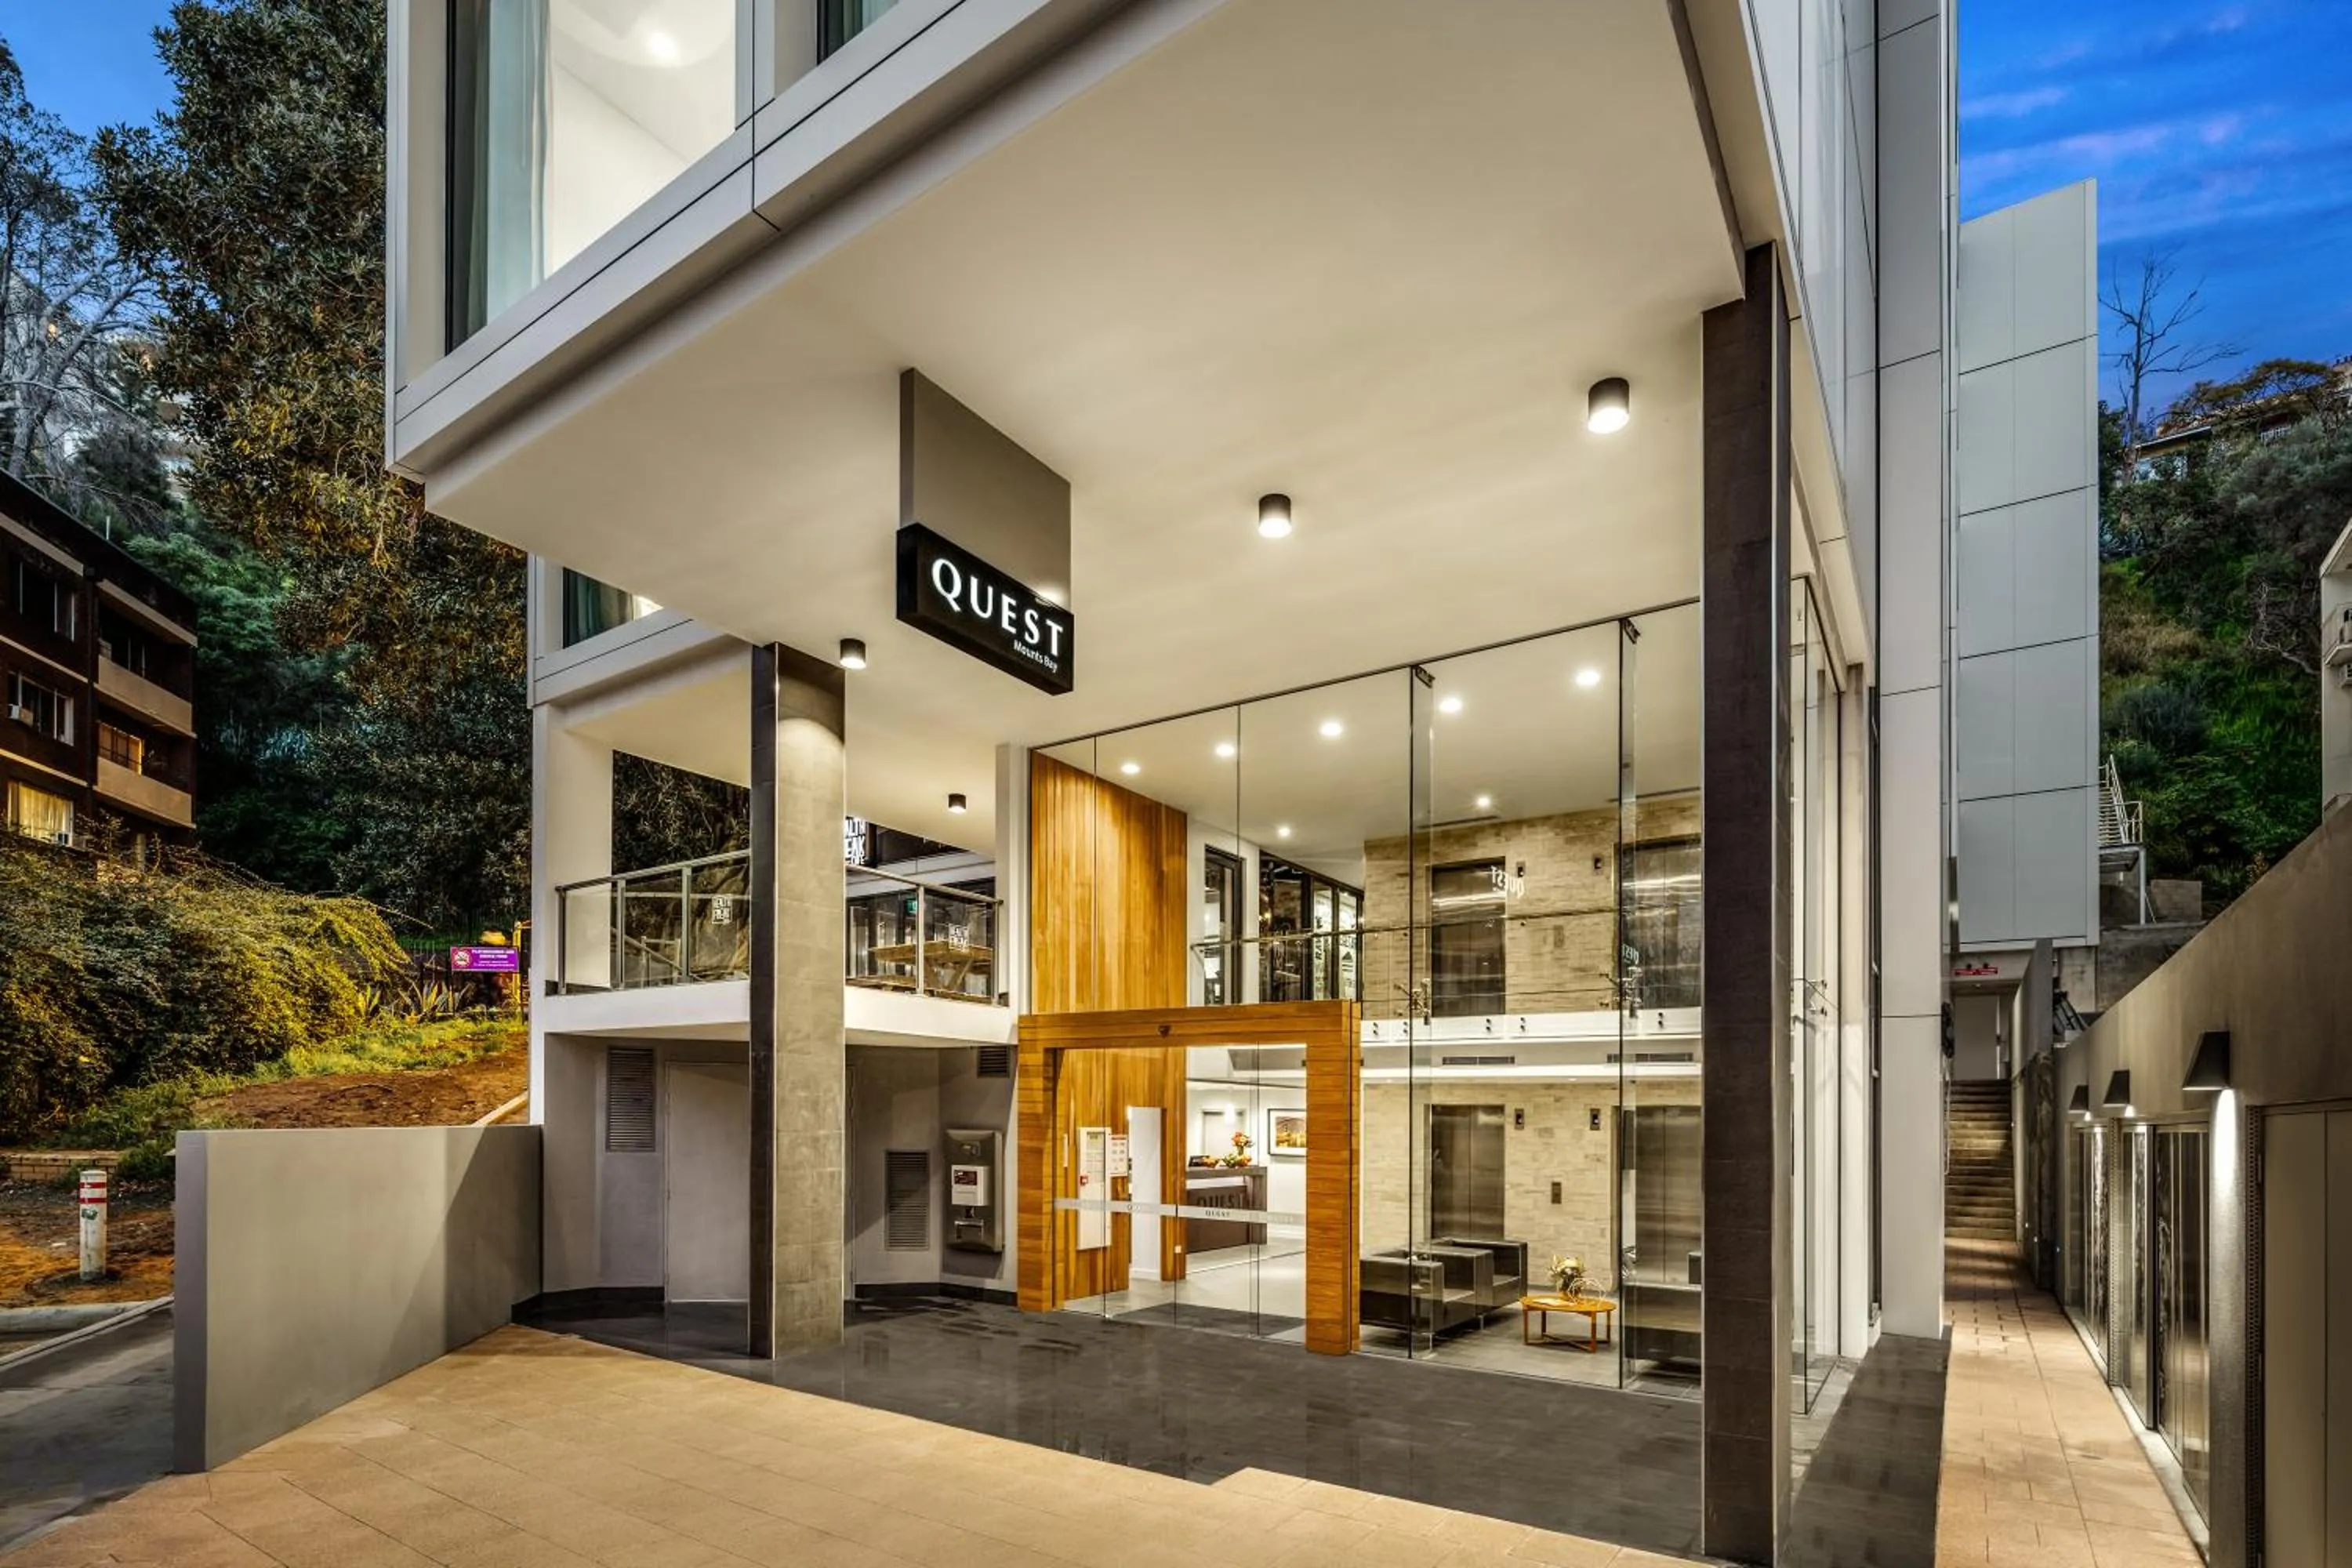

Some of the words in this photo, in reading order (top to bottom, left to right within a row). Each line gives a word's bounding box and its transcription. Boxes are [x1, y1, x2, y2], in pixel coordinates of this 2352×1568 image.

[931, 557, 1064, 657] QUEST
[1014, 639, 1043, 664] Mounts
[1044, 655, 1058, 673] Bay
